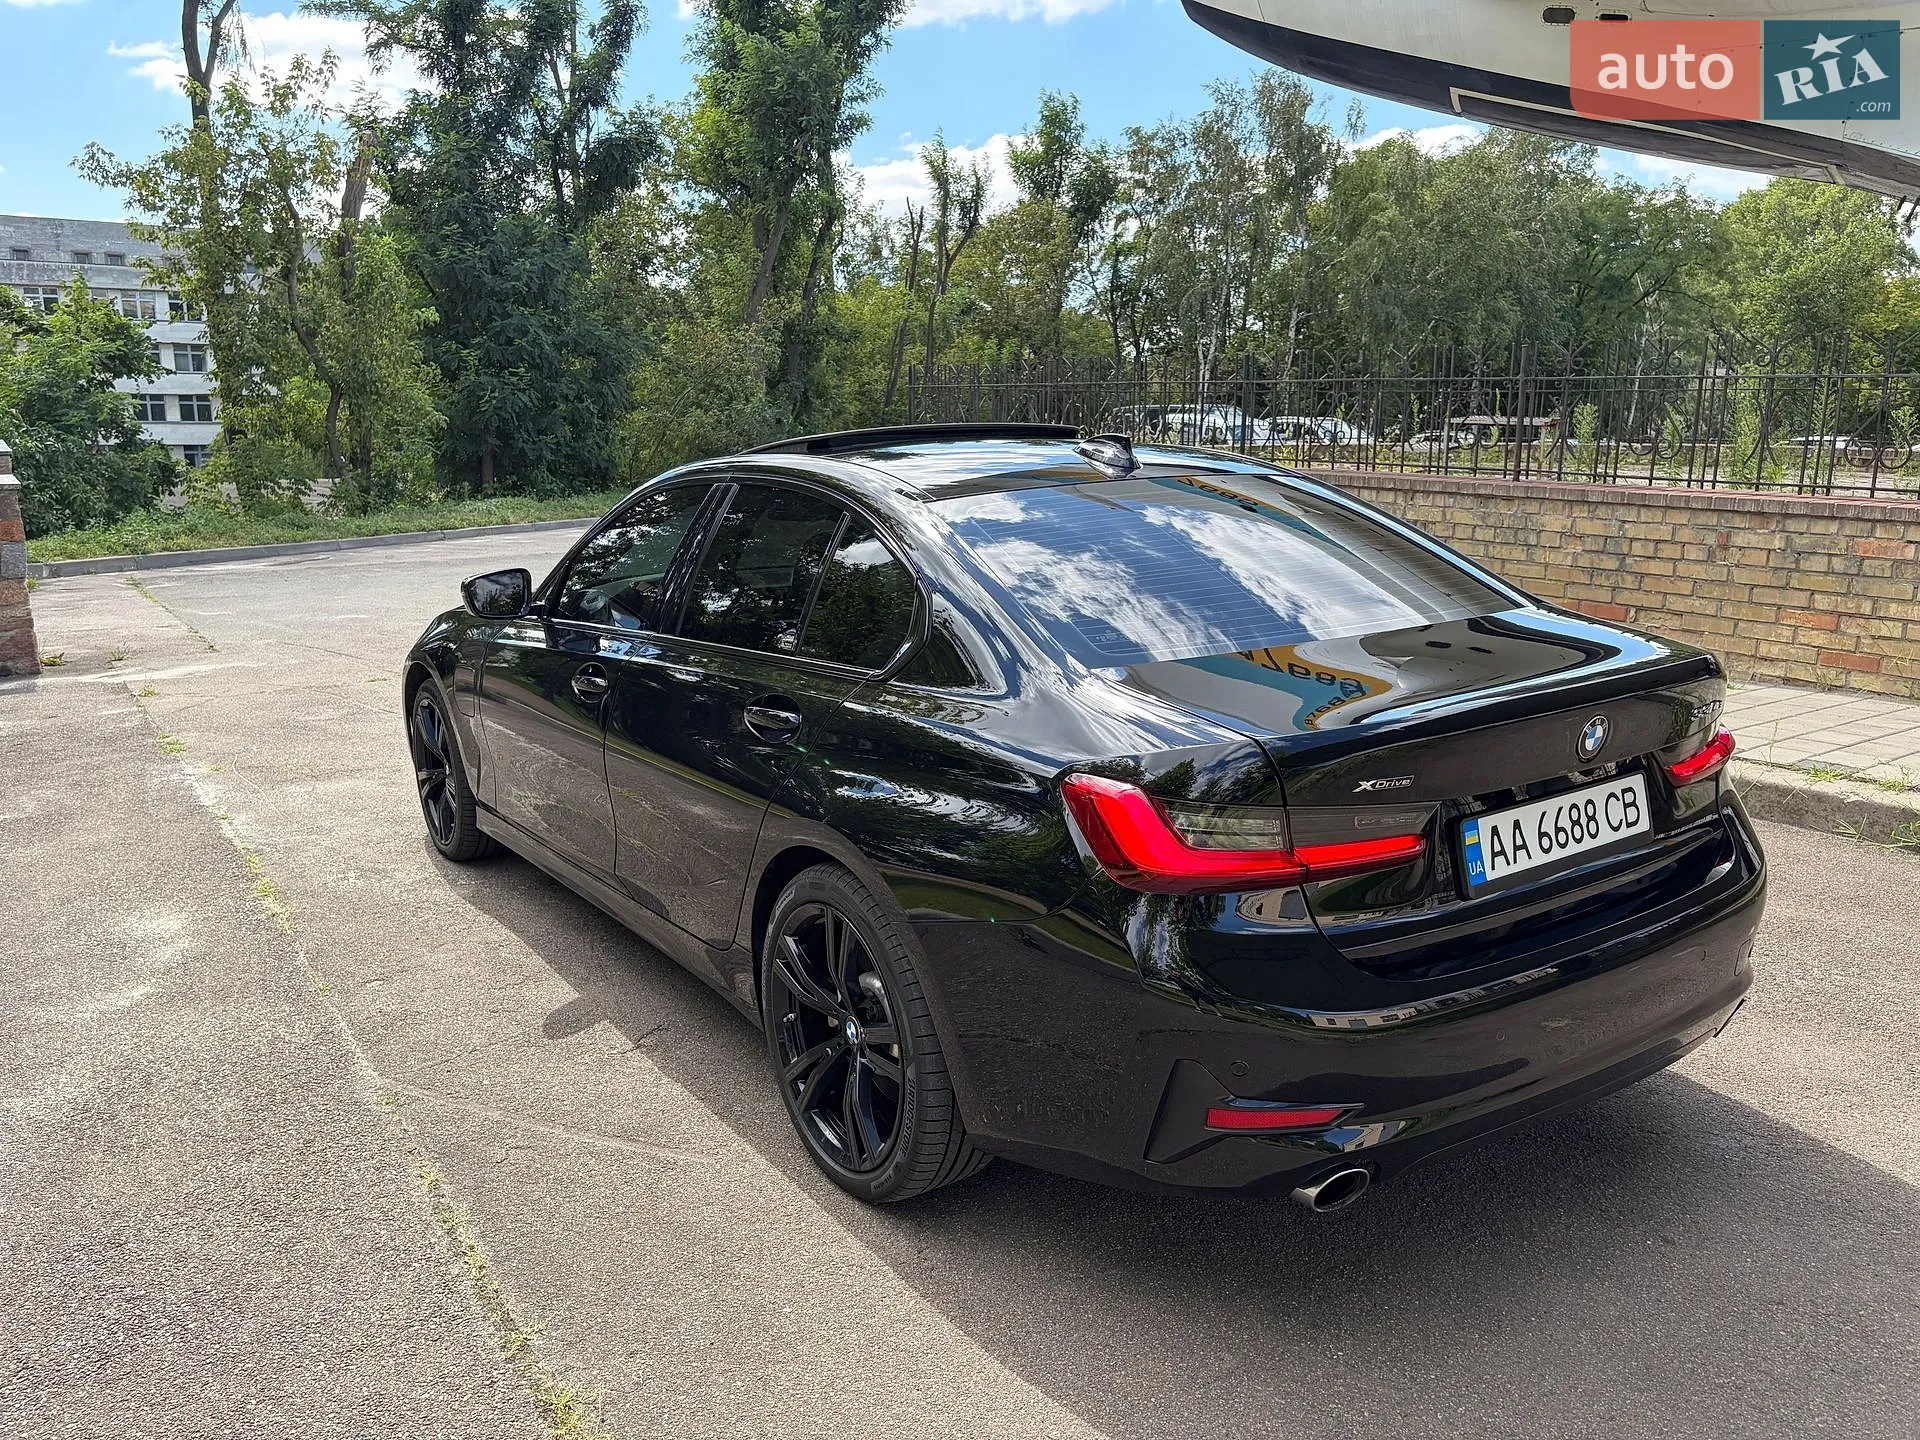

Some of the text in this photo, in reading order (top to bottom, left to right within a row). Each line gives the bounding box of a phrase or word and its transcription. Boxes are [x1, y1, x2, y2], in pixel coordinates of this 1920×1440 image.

[1491, 786, 1641, 871] AA 6688 CB
[1468, 860, 1485, 876] UA
